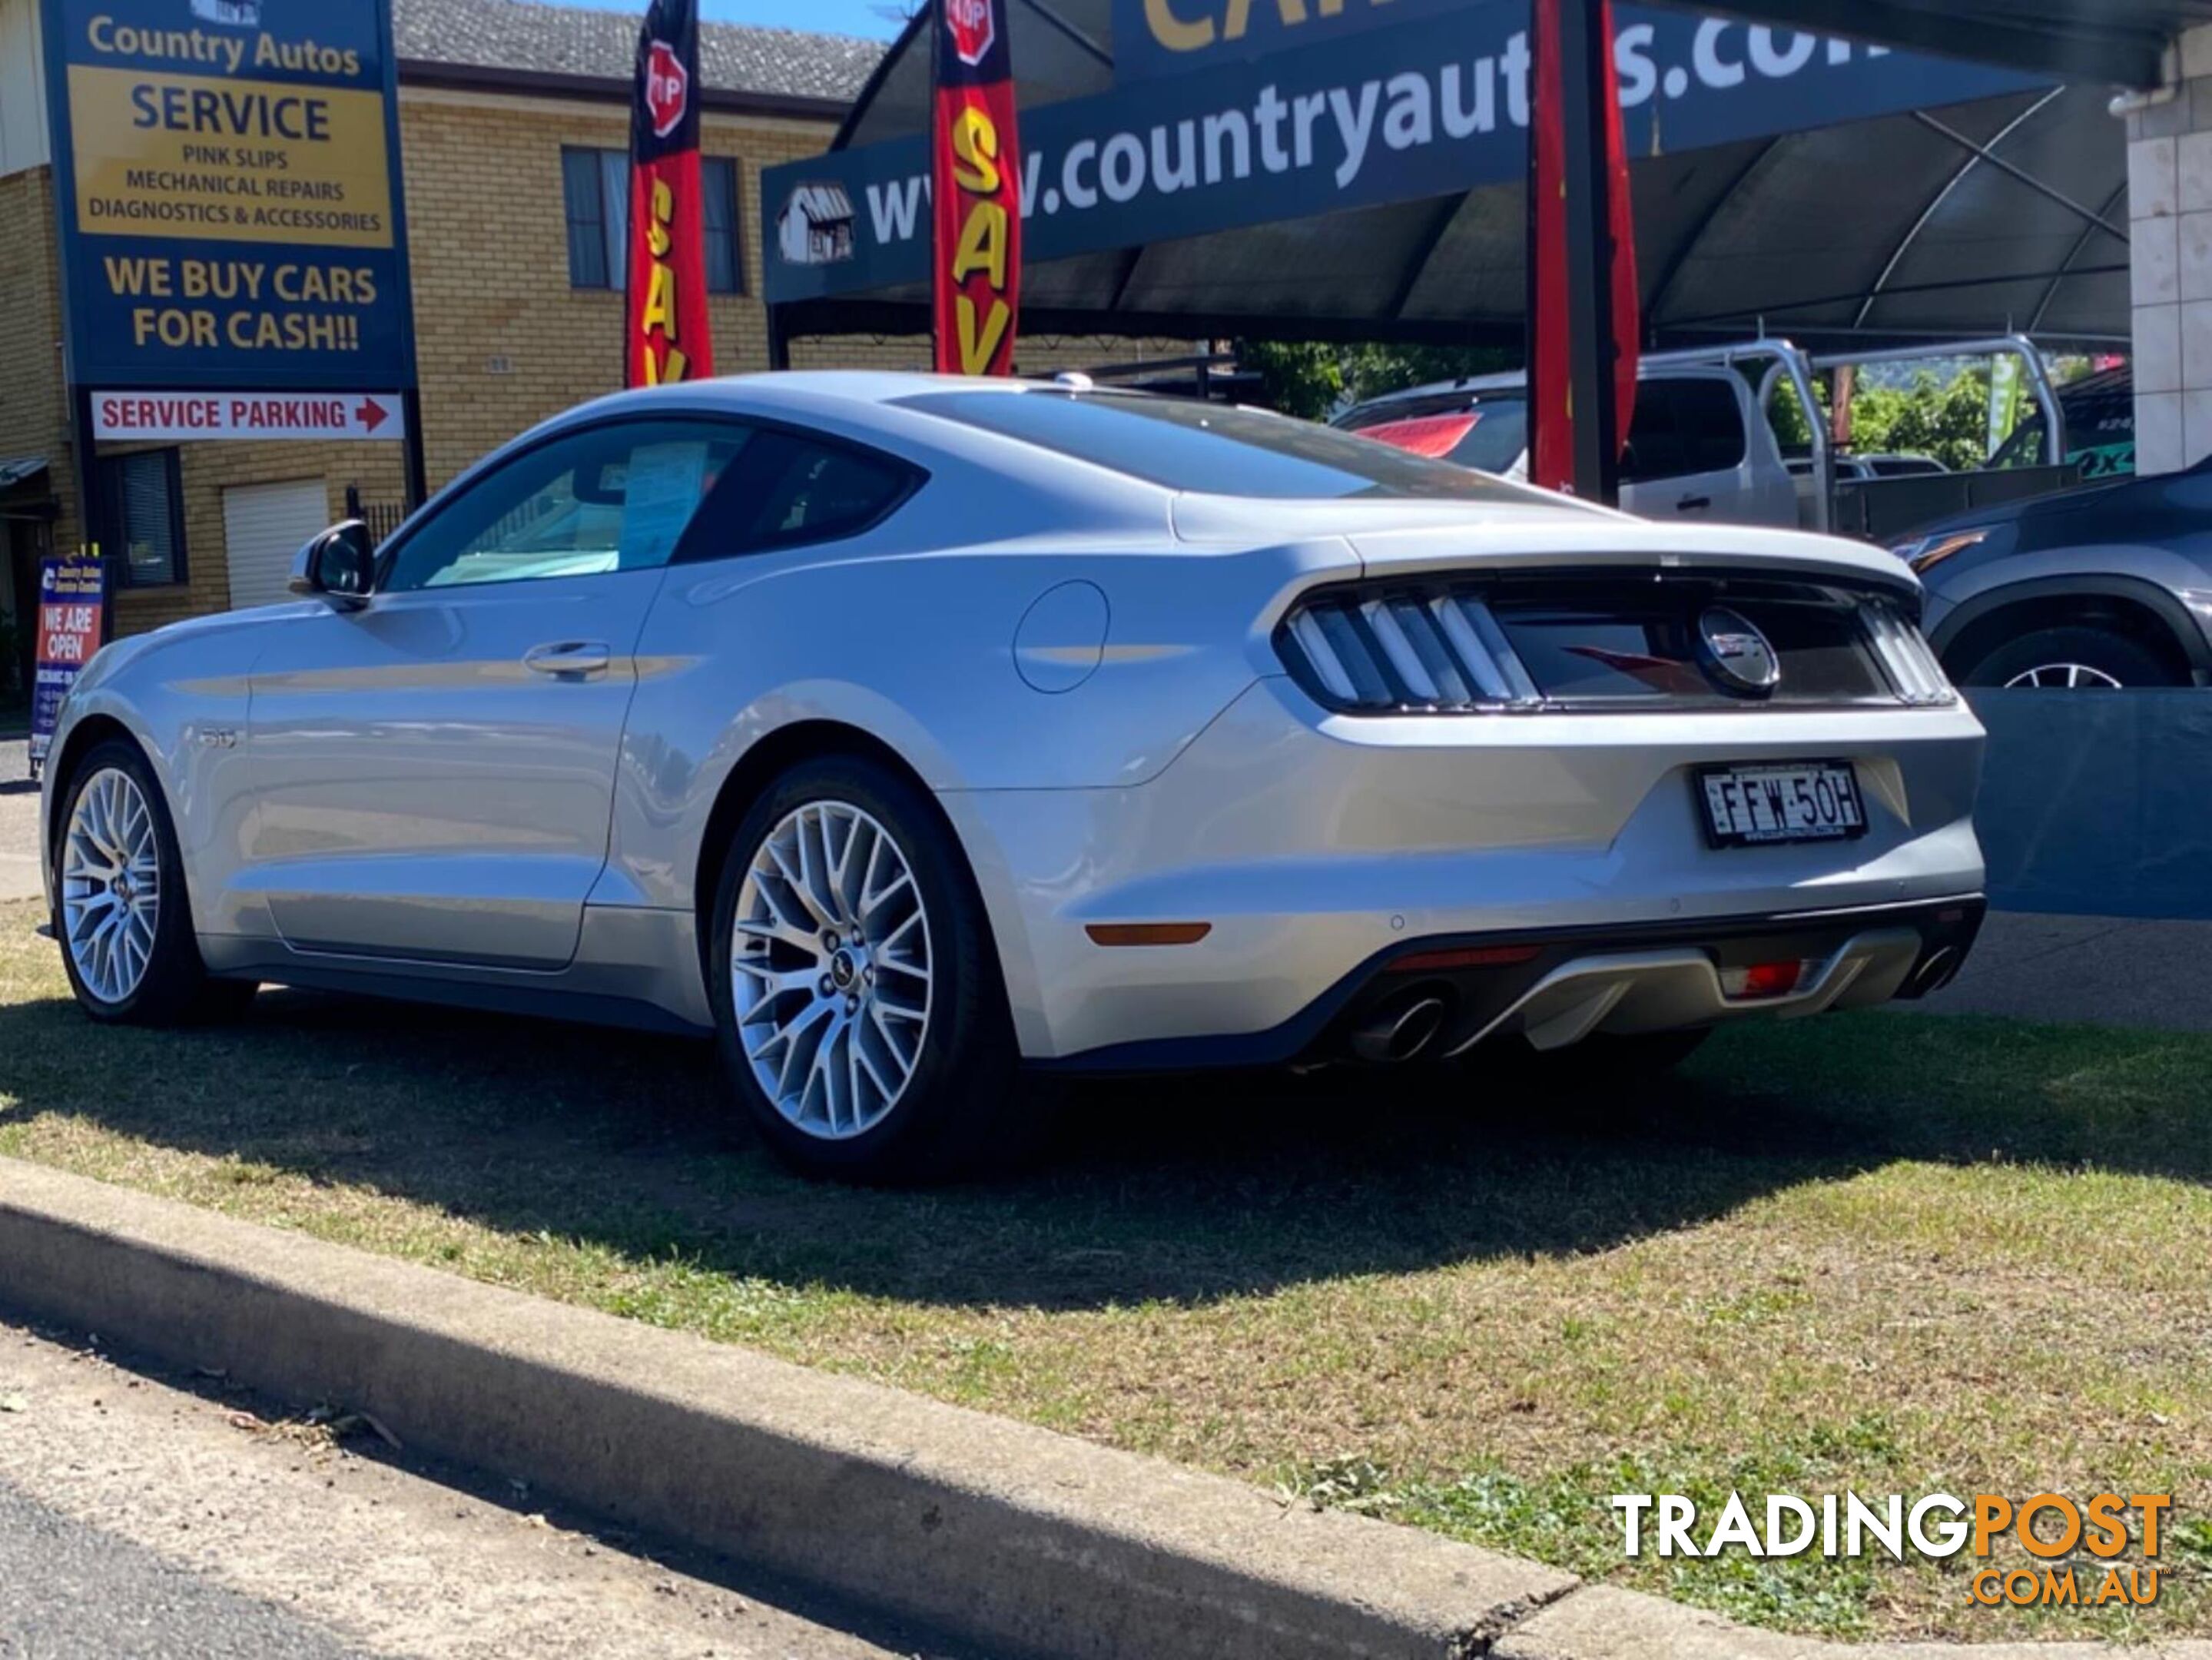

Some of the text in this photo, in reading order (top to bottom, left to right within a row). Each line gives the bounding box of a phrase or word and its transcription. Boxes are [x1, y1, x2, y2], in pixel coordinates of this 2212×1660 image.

[88, 15, 360, 76] Country Autos
[132, 84, 330, 141] SERVICE
[183, 144, 288, 169] PINK SLIPS
[126, 170, 345, 201] MECHANICAL REPAIRS
[89, 198, 381, 232] DIAGNOSTICS & ACCESSORIES
[104, 257, 377, 303] WE BUY CARS
[133, 309, 360, 351] FOR CASH!!
[102, 399, 347, 429] SERVICE PARKING
[45, 606, 92, 633] WE ARE
[48, 633, 83, 659] OPEN
